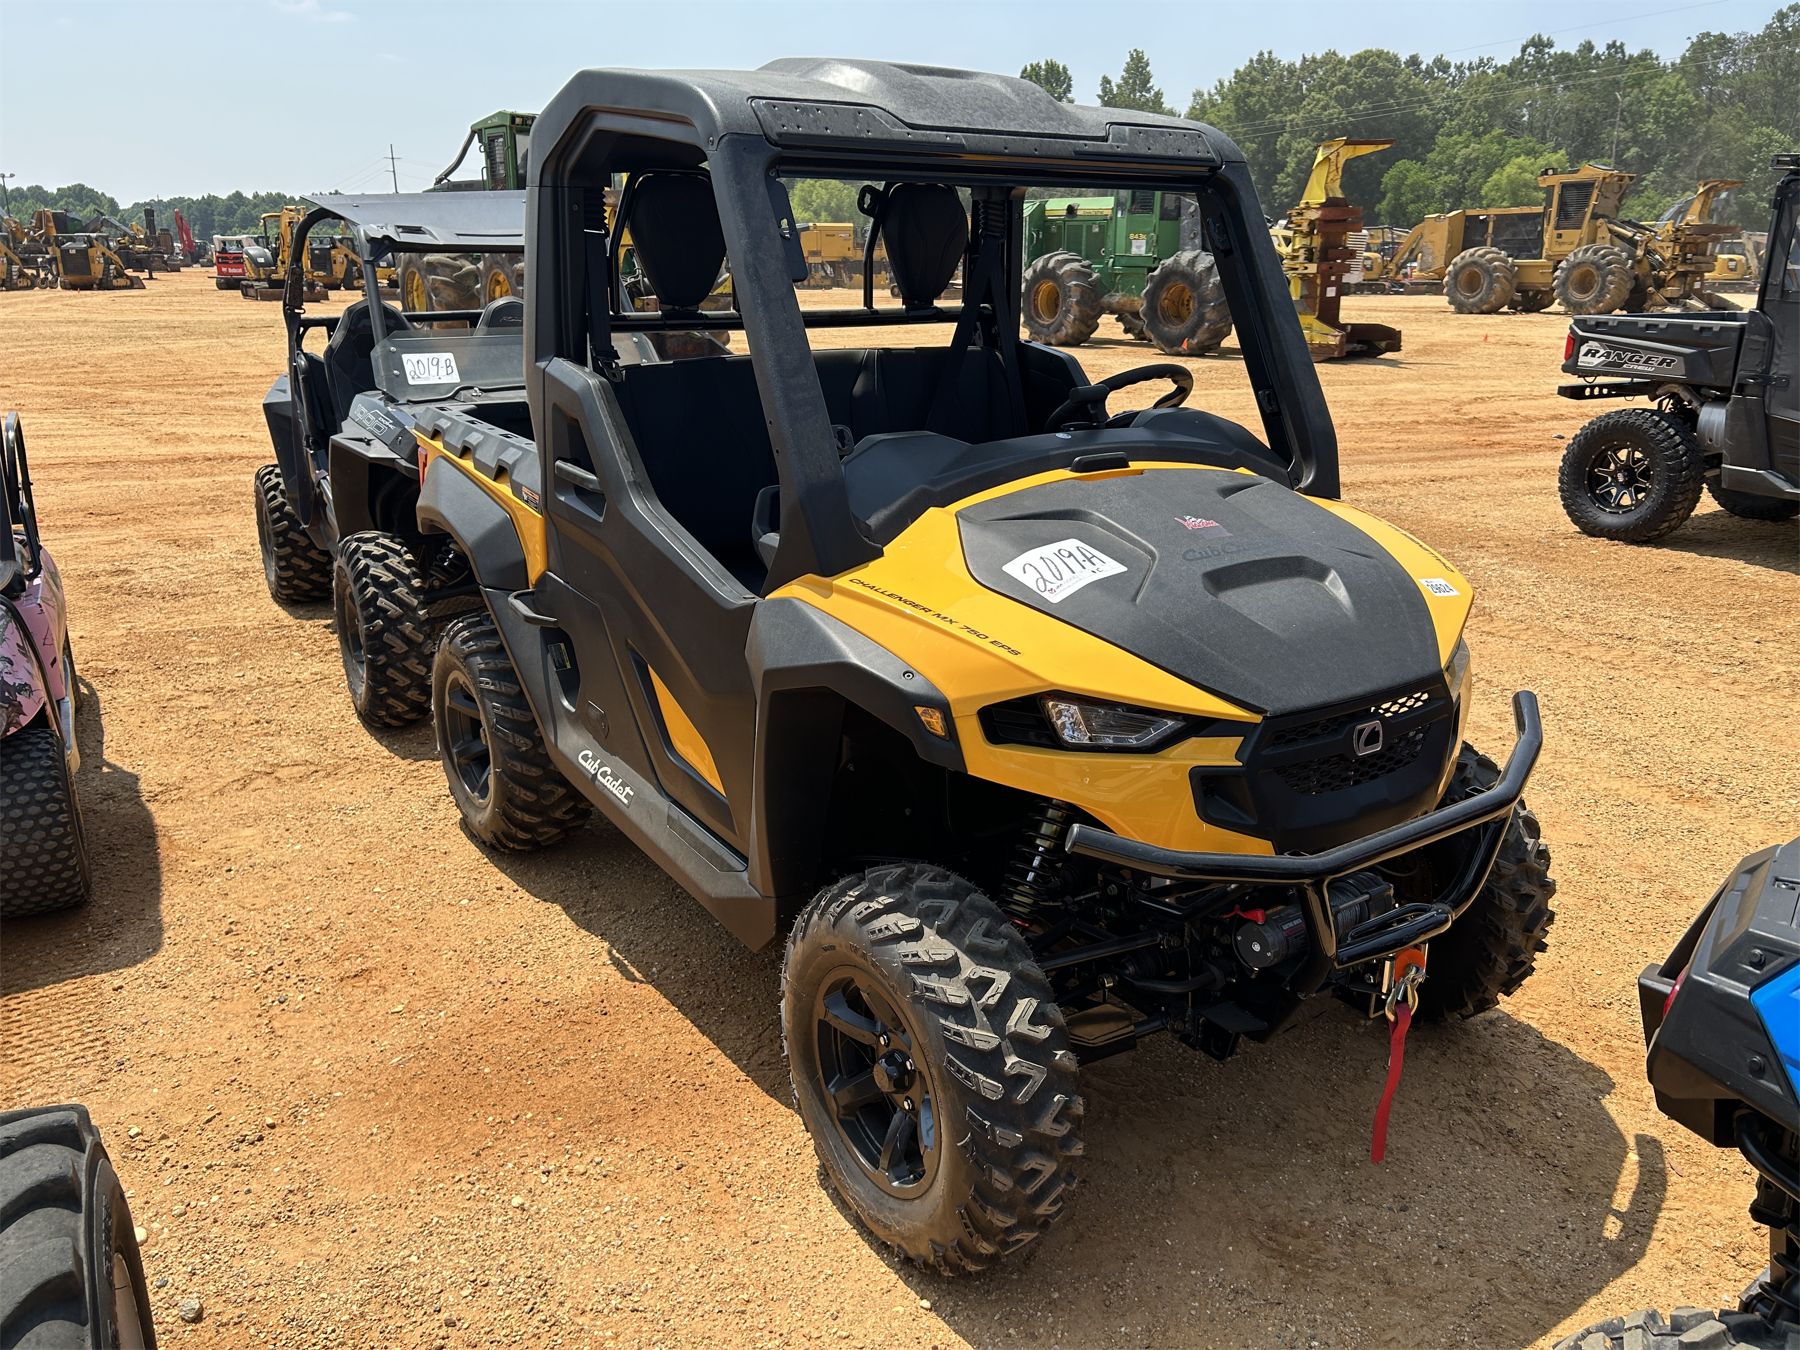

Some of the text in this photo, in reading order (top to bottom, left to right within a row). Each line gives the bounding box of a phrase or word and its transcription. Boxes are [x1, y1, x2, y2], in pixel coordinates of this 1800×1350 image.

[1582, 348, 1677, 368] RANGER
[1622, 364, 1655, 372] CREW
[848, 578, 1022, 656] CHALLENGER MX 750 EPS
[578, 750, 634, 804] Cub Cadet
